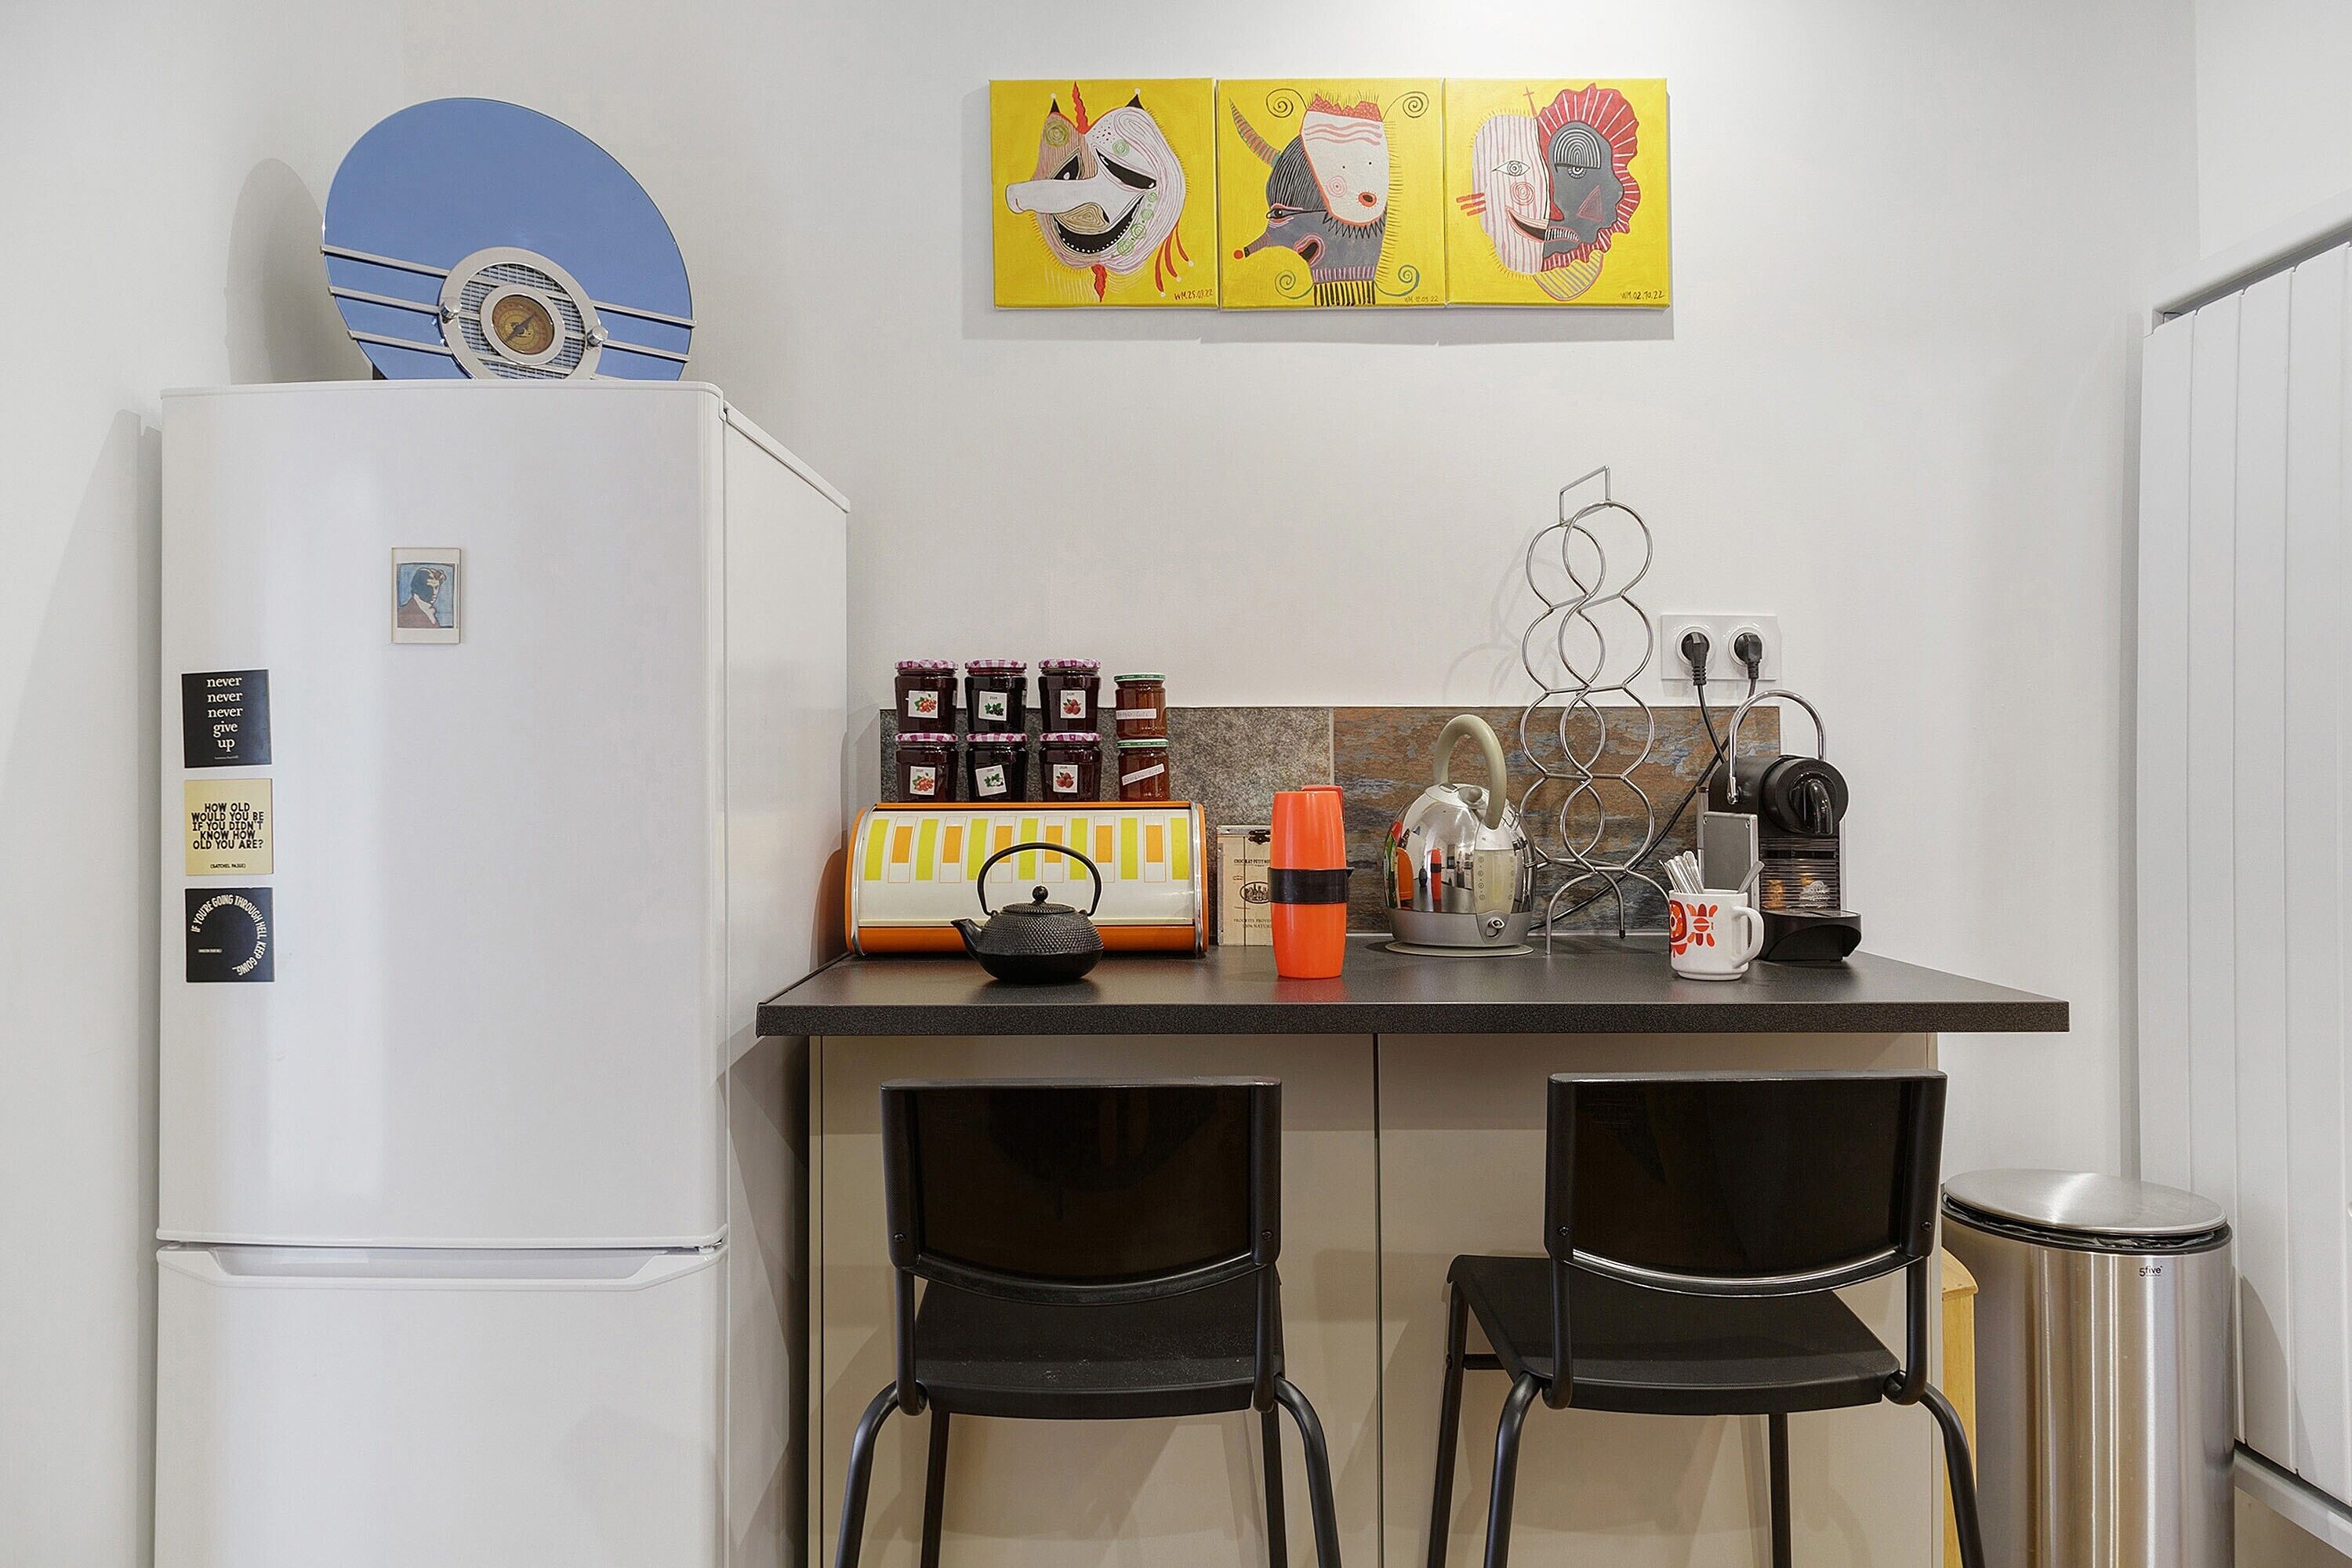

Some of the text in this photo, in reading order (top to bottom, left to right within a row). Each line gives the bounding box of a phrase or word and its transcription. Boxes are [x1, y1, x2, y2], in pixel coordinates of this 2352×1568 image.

[206, 677, 242, 688] never
[207, 692, 243, 702] never
[207, 707, 243, 718] never
[212, 720, 238, 738] give
[216, 739, 235, 753] up
[205, 803, 250, 812] HOW OLD
[191, 811, 264, 822] WOULD YOU BE
[192, 821, 263, 831] IF YOU DIDN'T
[200, 830, 256, 840] KNOW HOW
[193, 839, 264, 849] OLD YOU ARE?
[193, 901, 214, 925] YOU'RE
[211, 895, 234, 908] GOING
[234, 895, 263, 923] THROUGH
[253, 941, 267, 960] KEEP
